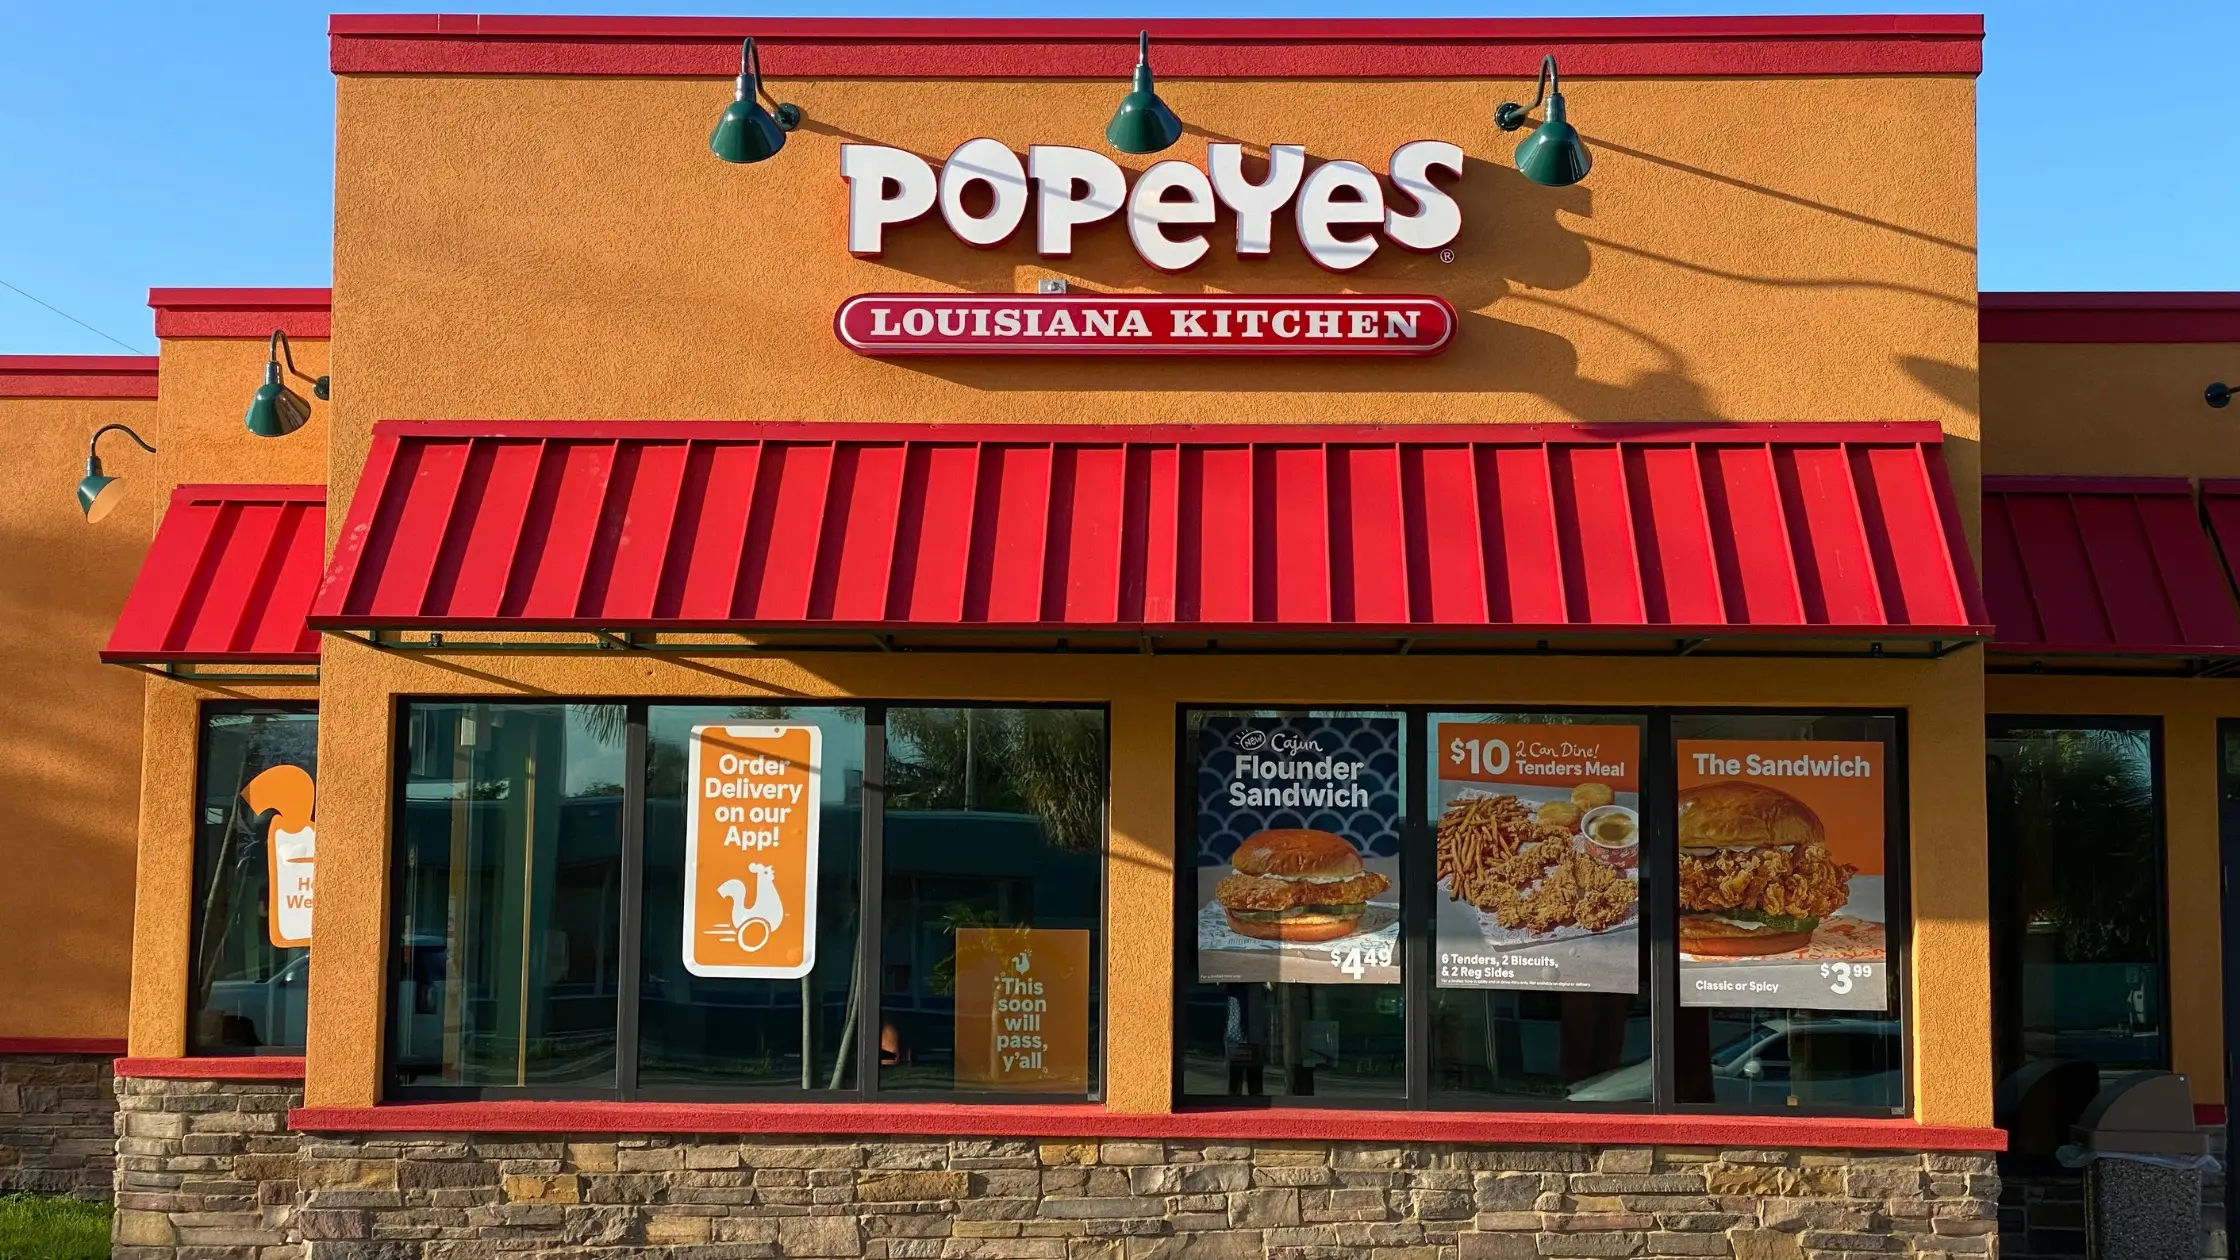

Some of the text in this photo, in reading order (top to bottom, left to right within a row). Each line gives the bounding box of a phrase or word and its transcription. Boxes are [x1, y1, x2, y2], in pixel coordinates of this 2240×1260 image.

[870, 308, 1421, 339] LOUISIANA KITCHEN
[1271, 733, 1323, 756] Cajun
[1516, 741, 1600, 759] 2 Can Dine!
[718, 754, 790, 776] Order
[1450, 737, 1510, 775] $10
[1235, 755, 1364, 780] Flounder
[1515, 760, 1625, 777] Tenders Meal
[1693, 754, 1871, 777] The Sandwich
[705, 778, 804, 804] Delivery
[1229, 782, 1369, 808] Sandwich
[715, 807, 791, 823] on our
[724, 825, 780, 850] App!
[1441, 953, 1559, 968] 6 Tenders, 2 Biscuits,
[1441, 966, 1515, 980] & 2 Reg Sides
[1002, 977, 1044, 995] This
[1695, 980, 1779, 993] Classic or Spicy
[998, 998, 1046, 1012] soon
[1005, 1014, 1040, 1031] will
[996, 1035, 1048, 1052] pass,
